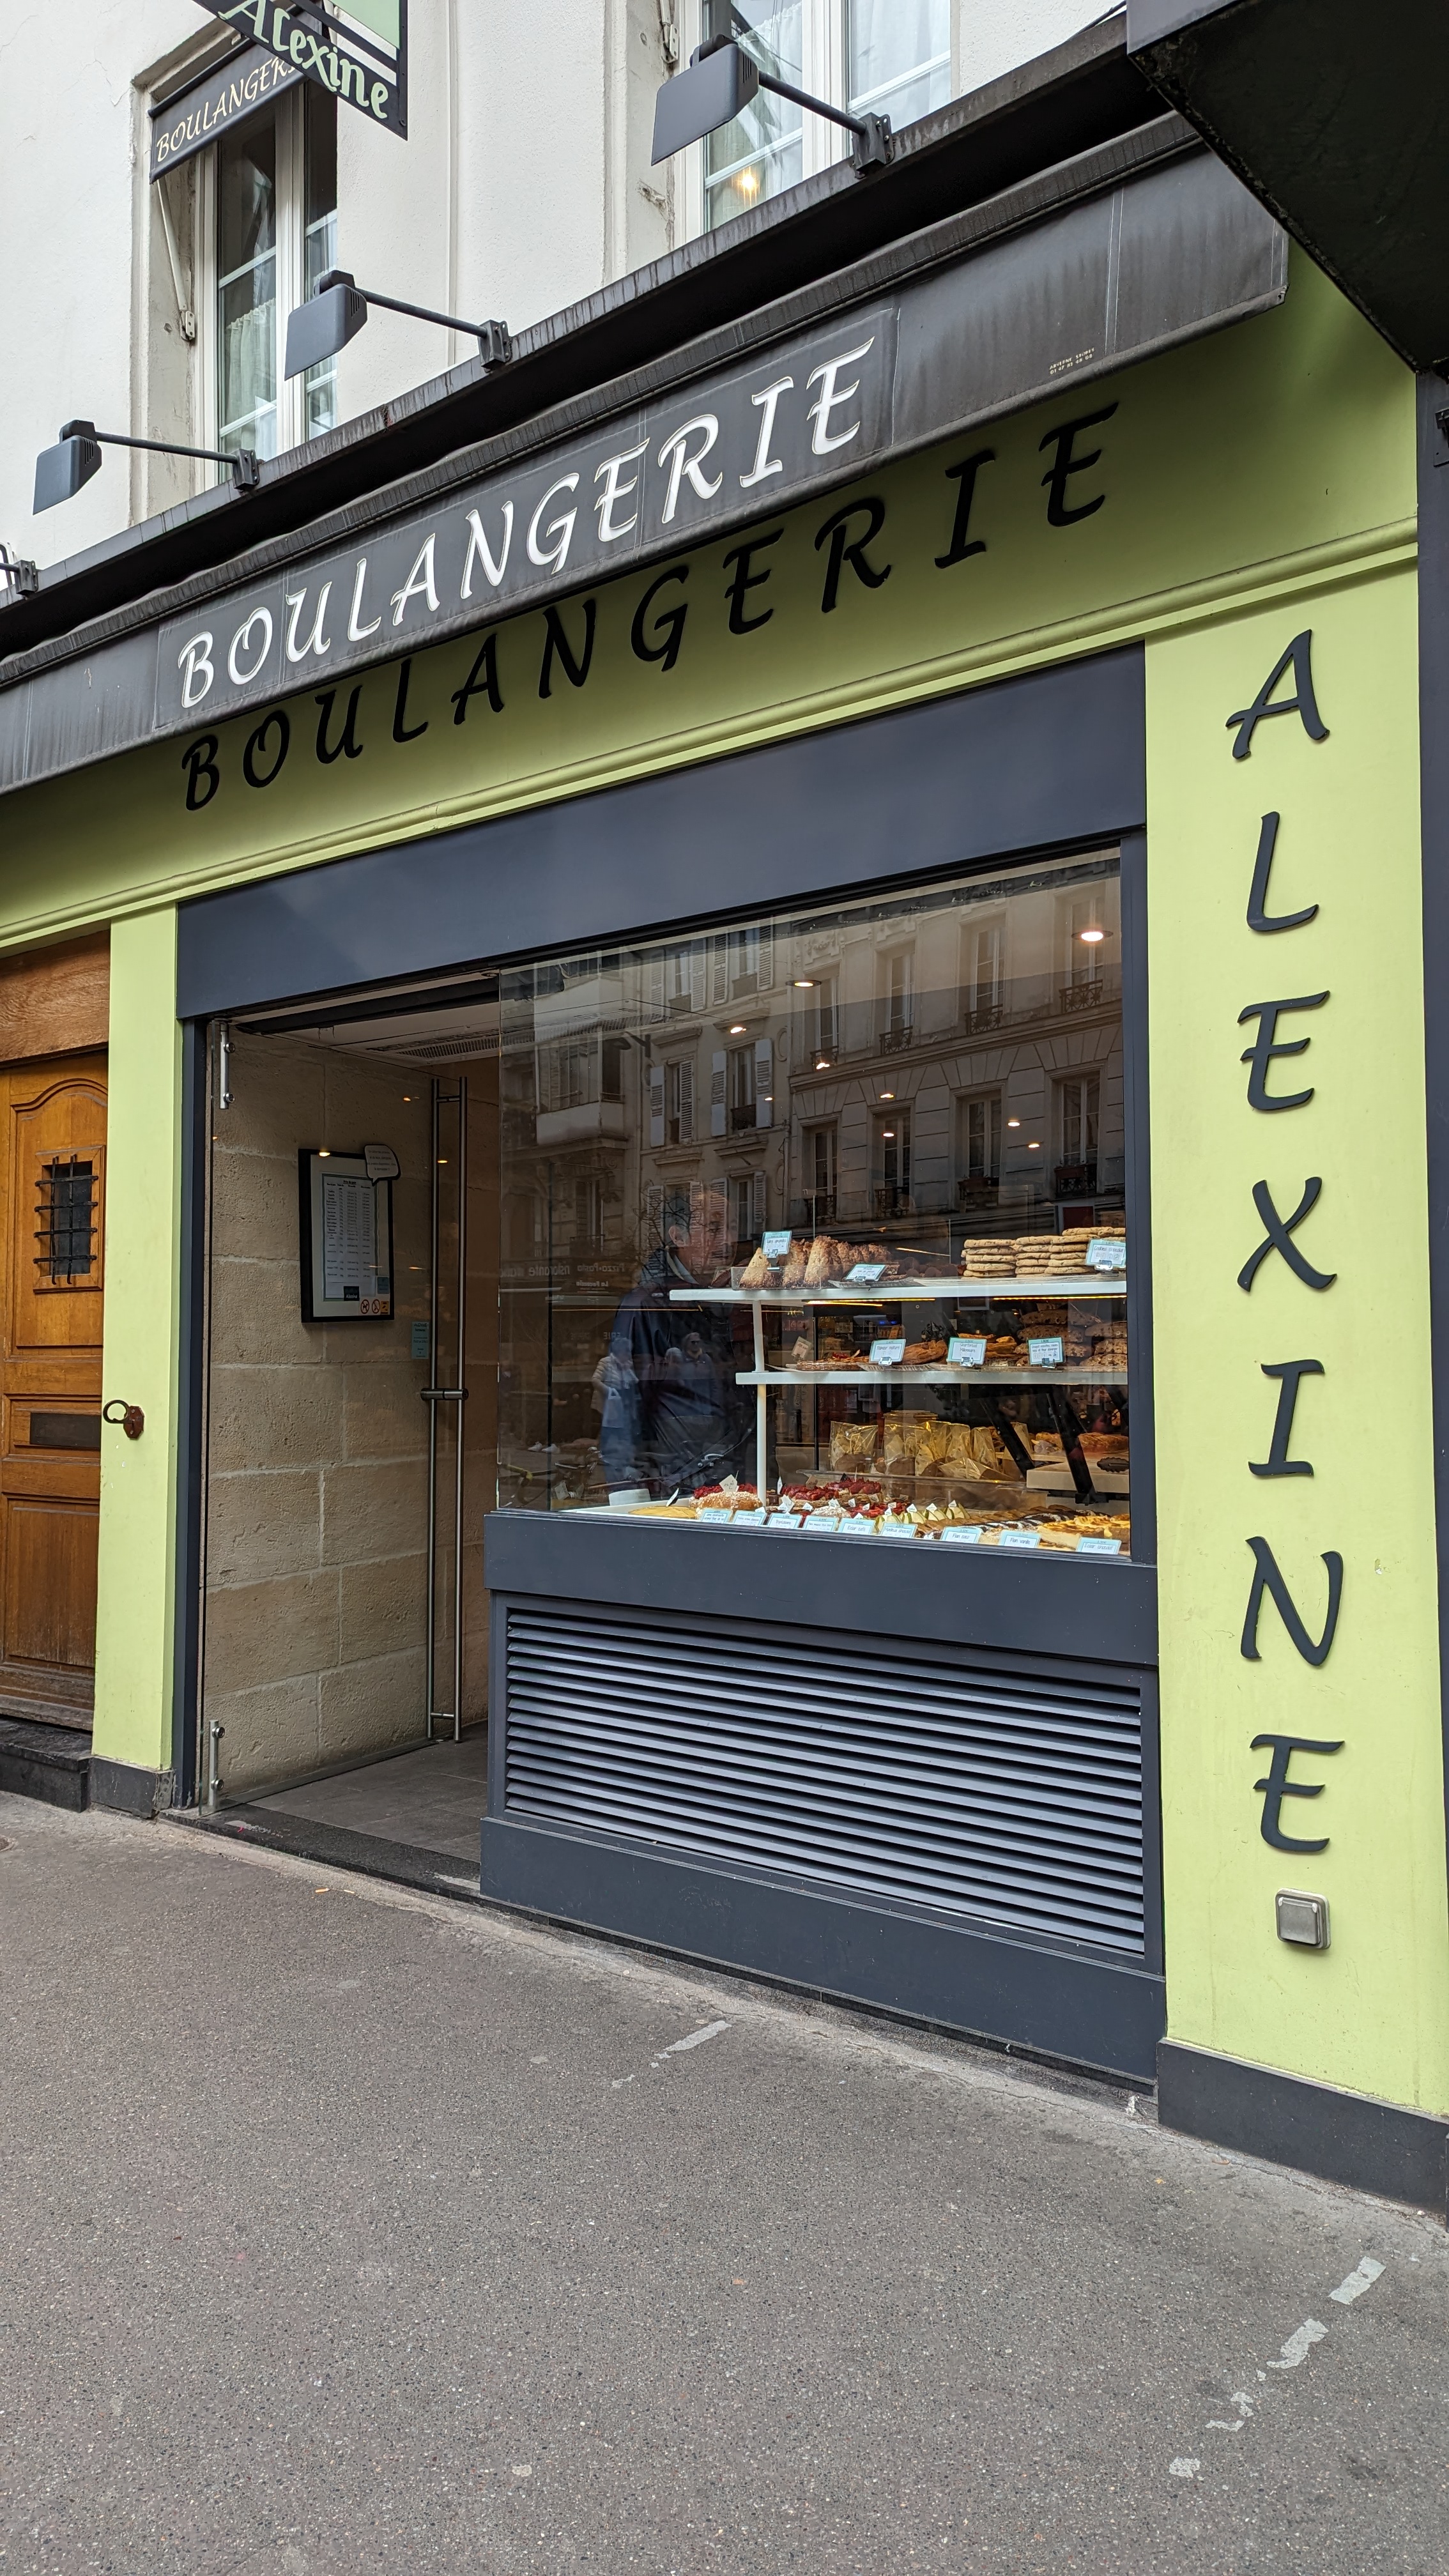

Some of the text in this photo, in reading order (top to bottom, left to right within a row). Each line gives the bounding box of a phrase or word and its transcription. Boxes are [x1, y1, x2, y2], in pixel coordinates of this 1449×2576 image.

[178, 336, 875, 709] BOULANGERIE
[181, 402, 1119, 811] BOULANGERIE
[1225, 629, 1346, 1852] ALEXINE
